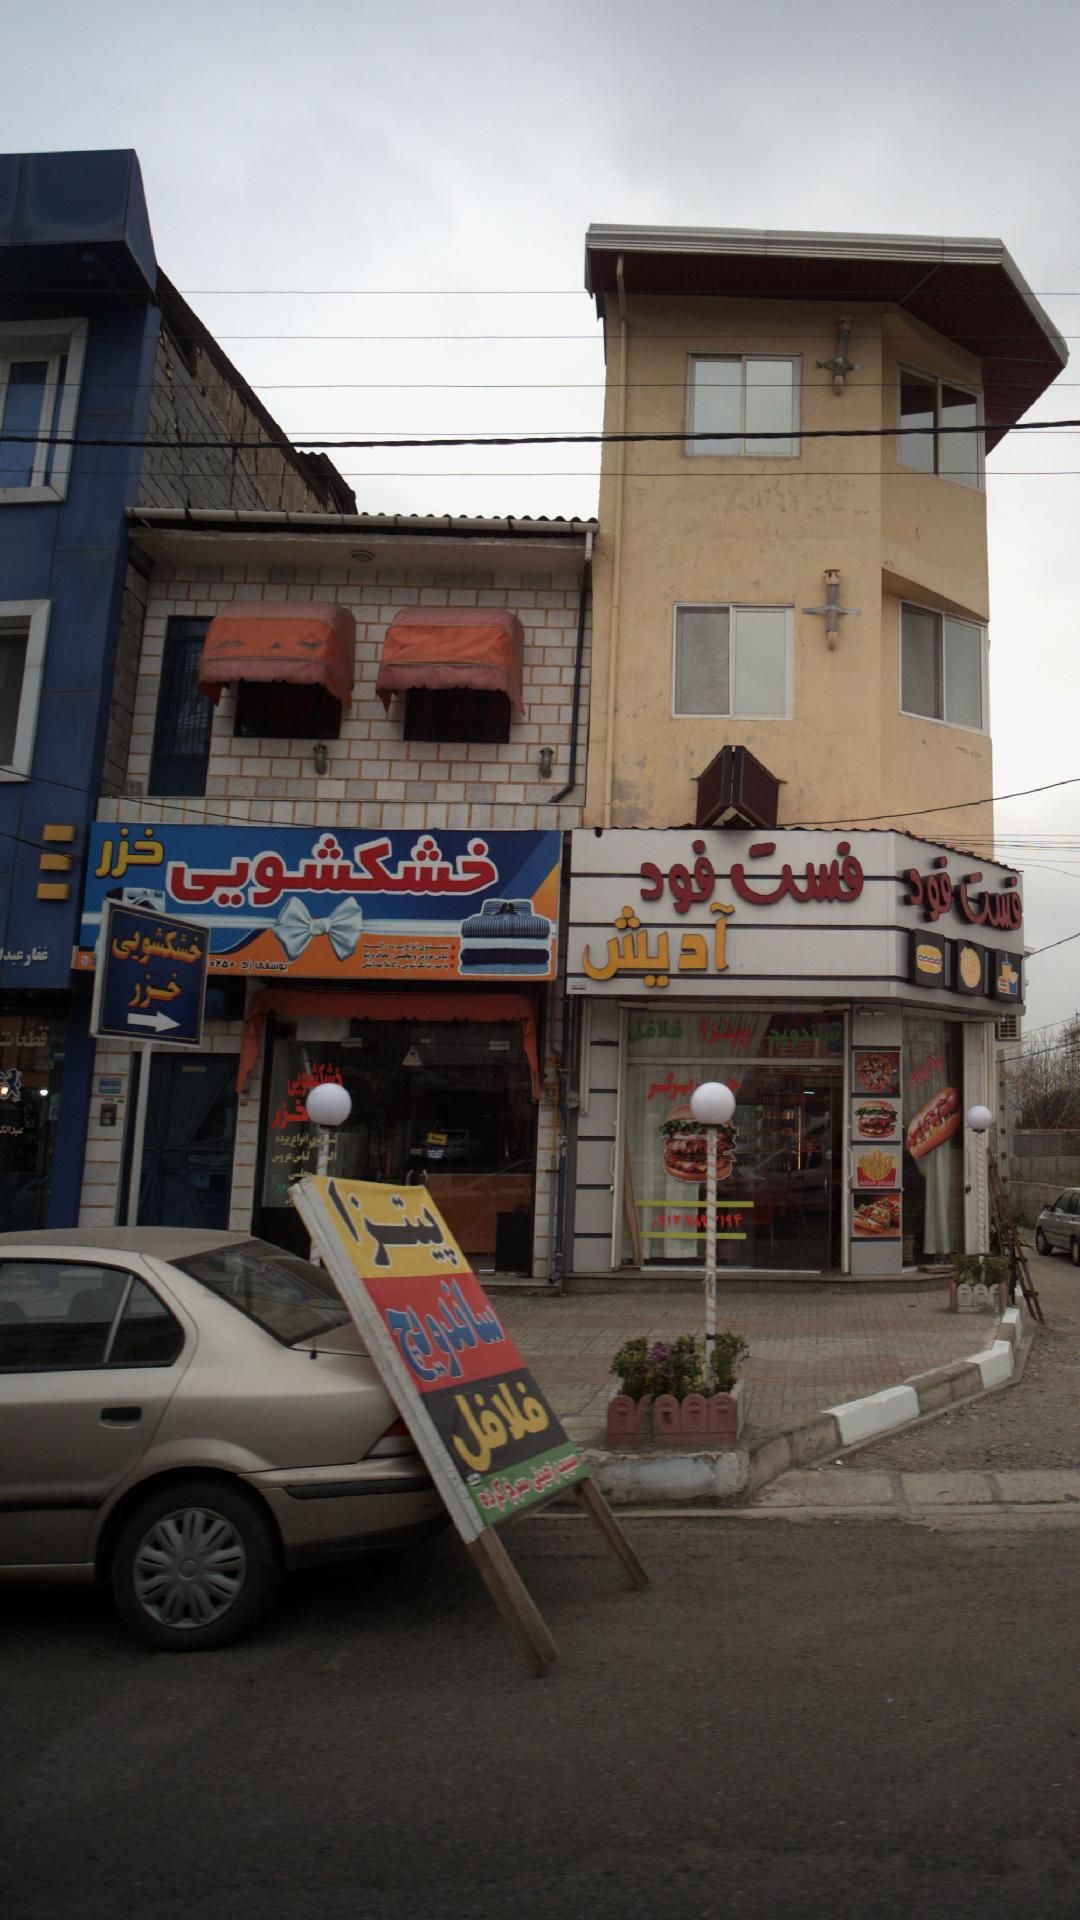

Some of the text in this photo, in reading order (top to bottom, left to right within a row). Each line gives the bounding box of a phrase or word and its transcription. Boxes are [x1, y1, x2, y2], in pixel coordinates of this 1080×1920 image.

[94, 827, 498, 906] خشکشویی خزر
[639, 840, 865, 913] فست فود
[903, 856, 1023, 931] فست فود
[111, 928, 203, 965] خشکشویی
[582, 902, 735, 988] آدیش
[128, 973, 182, 1009] خزر
[627, 1019, 684, 1043] فلافل
[325, 1178, 459, 1268] پیتزا
[453, 1381, 551, 1471] فلافل
